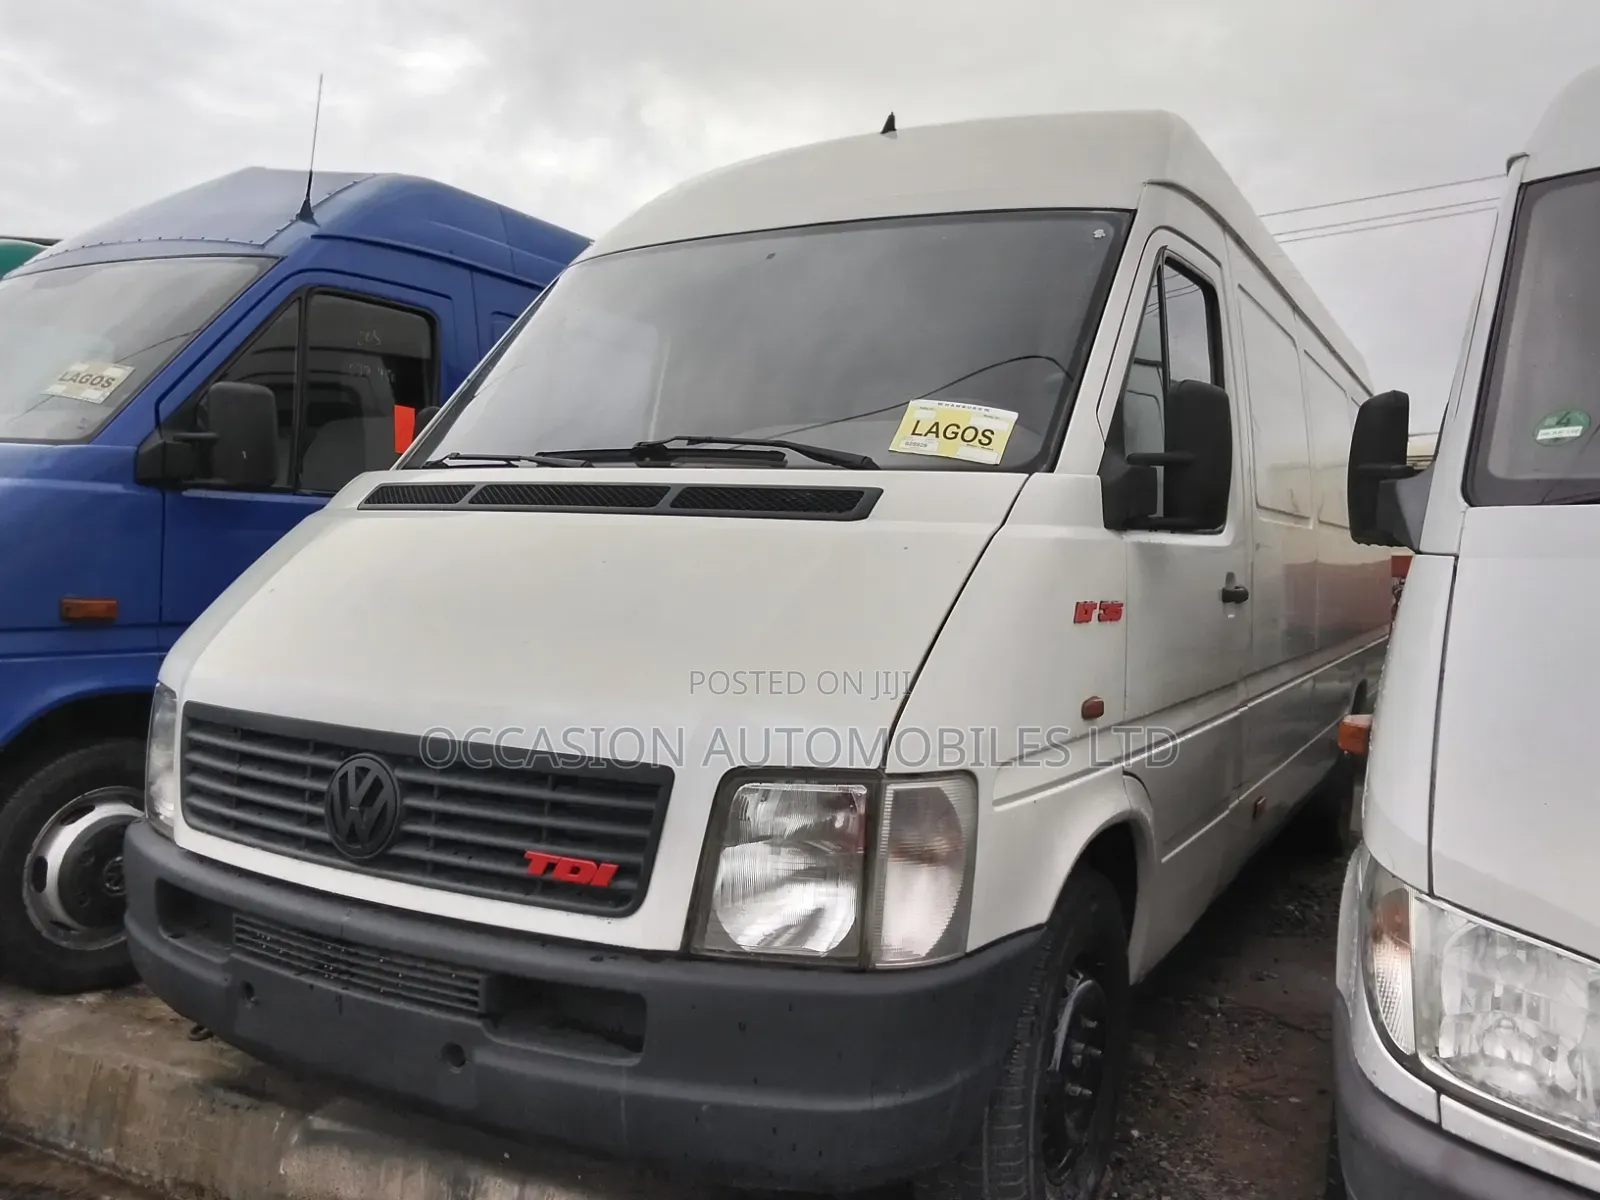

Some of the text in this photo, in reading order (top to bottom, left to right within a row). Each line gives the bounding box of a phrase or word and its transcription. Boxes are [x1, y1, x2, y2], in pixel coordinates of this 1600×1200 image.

[58, 371, 116, 388] LAGOS
[910, 419, 995, 446] LAGOS
[523, 849, 619, 887] TDI
